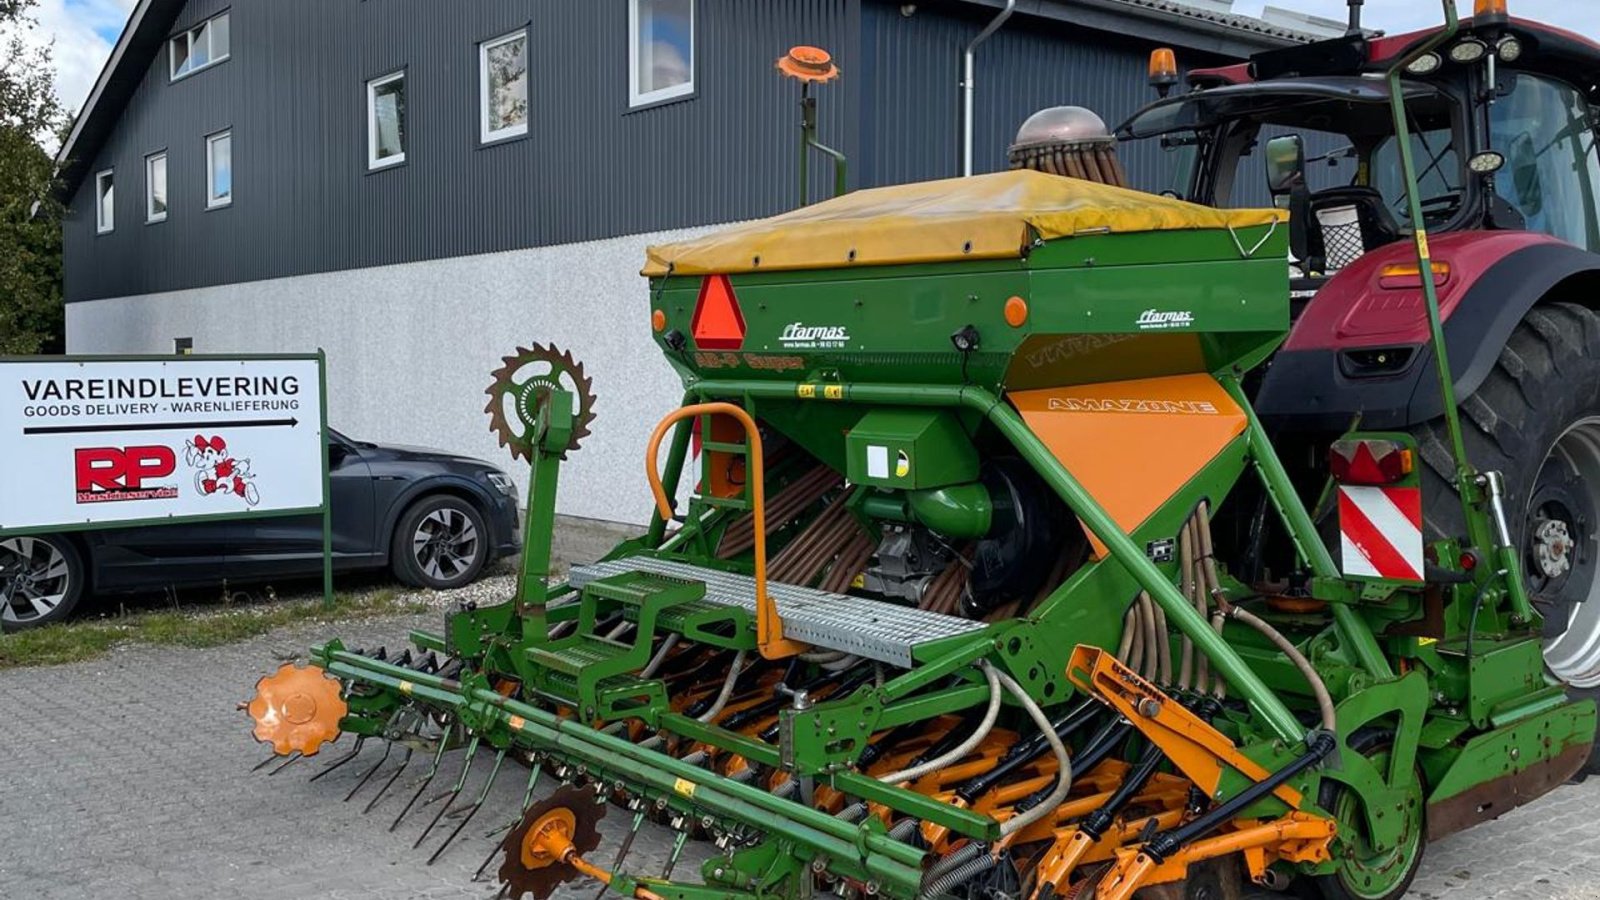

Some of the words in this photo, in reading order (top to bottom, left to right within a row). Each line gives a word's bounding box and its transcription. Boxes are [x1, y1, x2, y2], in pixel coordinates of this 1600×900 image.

[22, 376, 299, 400] VAREINDLEVERING
[24, 405, 81, 417] GOODS
[85, 403, 158, 416] DELIVERY
[170, 400, 299, 413] WARENLIEFERUNG
[1048, 398, 1219, 414] AMAZONE
[75, 445, 176, 491] RP
